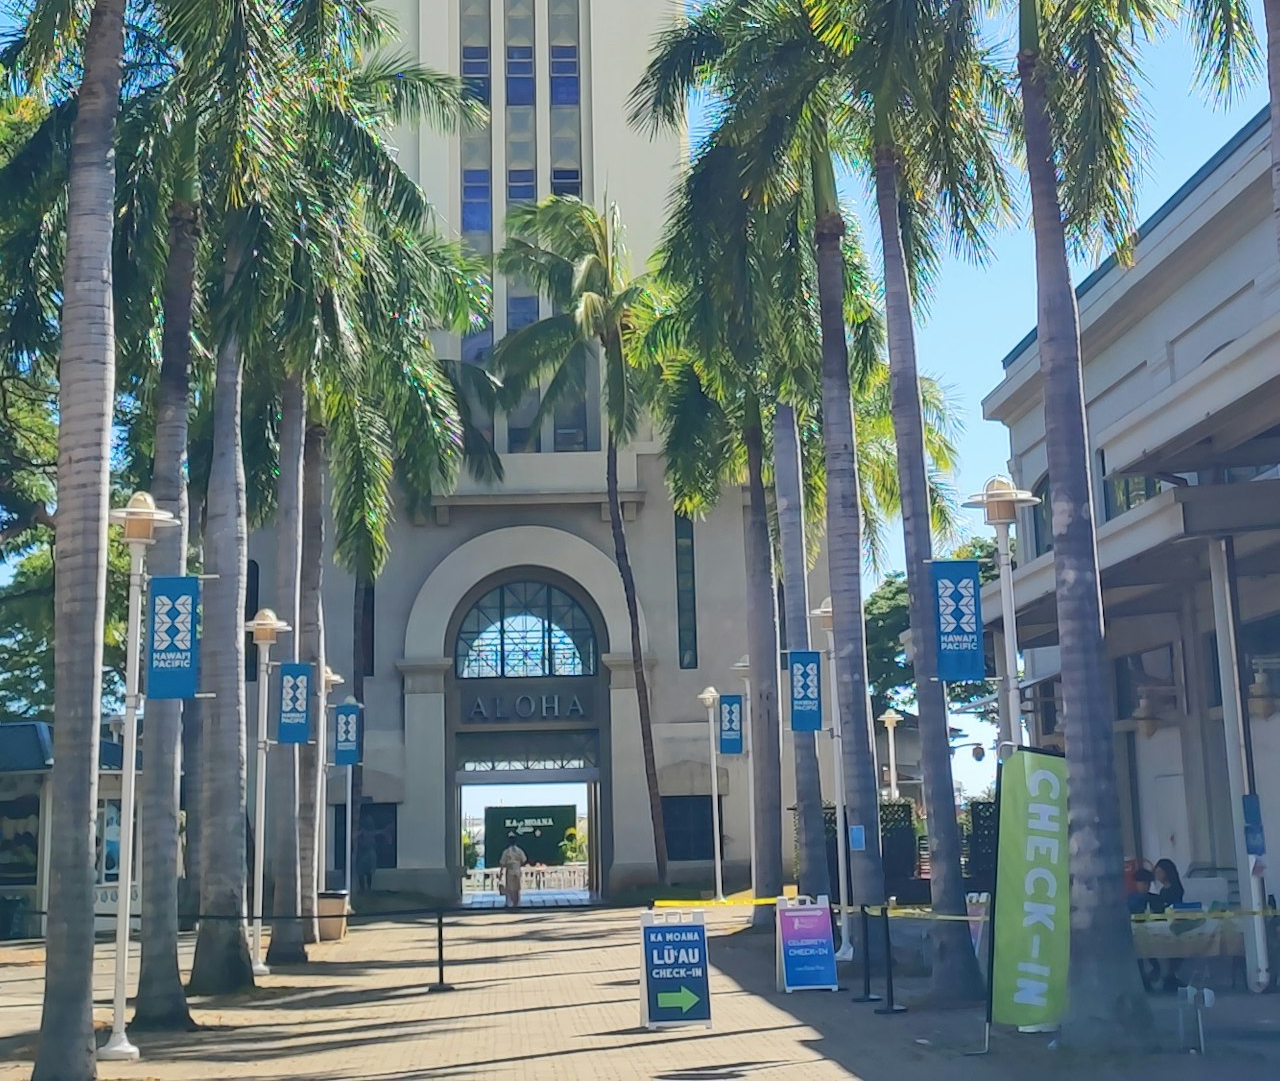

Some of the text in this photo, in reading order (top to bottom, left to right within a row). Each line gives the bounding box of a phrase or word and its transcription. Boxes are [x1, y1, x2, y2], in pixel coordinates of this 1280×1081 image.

[940, 642, 978, 651] PACIFIC
[152, 659, 191, 668] PACIFIC
[470, 694, 585, 720] ALOHA
[504, 819, 517, 827] KA
[1013, 769, 1061, 1007] CHECK-IN
[650, 931, 700, 942] KA MOANA
[788, 948, 829, 956] CHECK-IN
[651, 967, 703, 979] CHECK-IN
